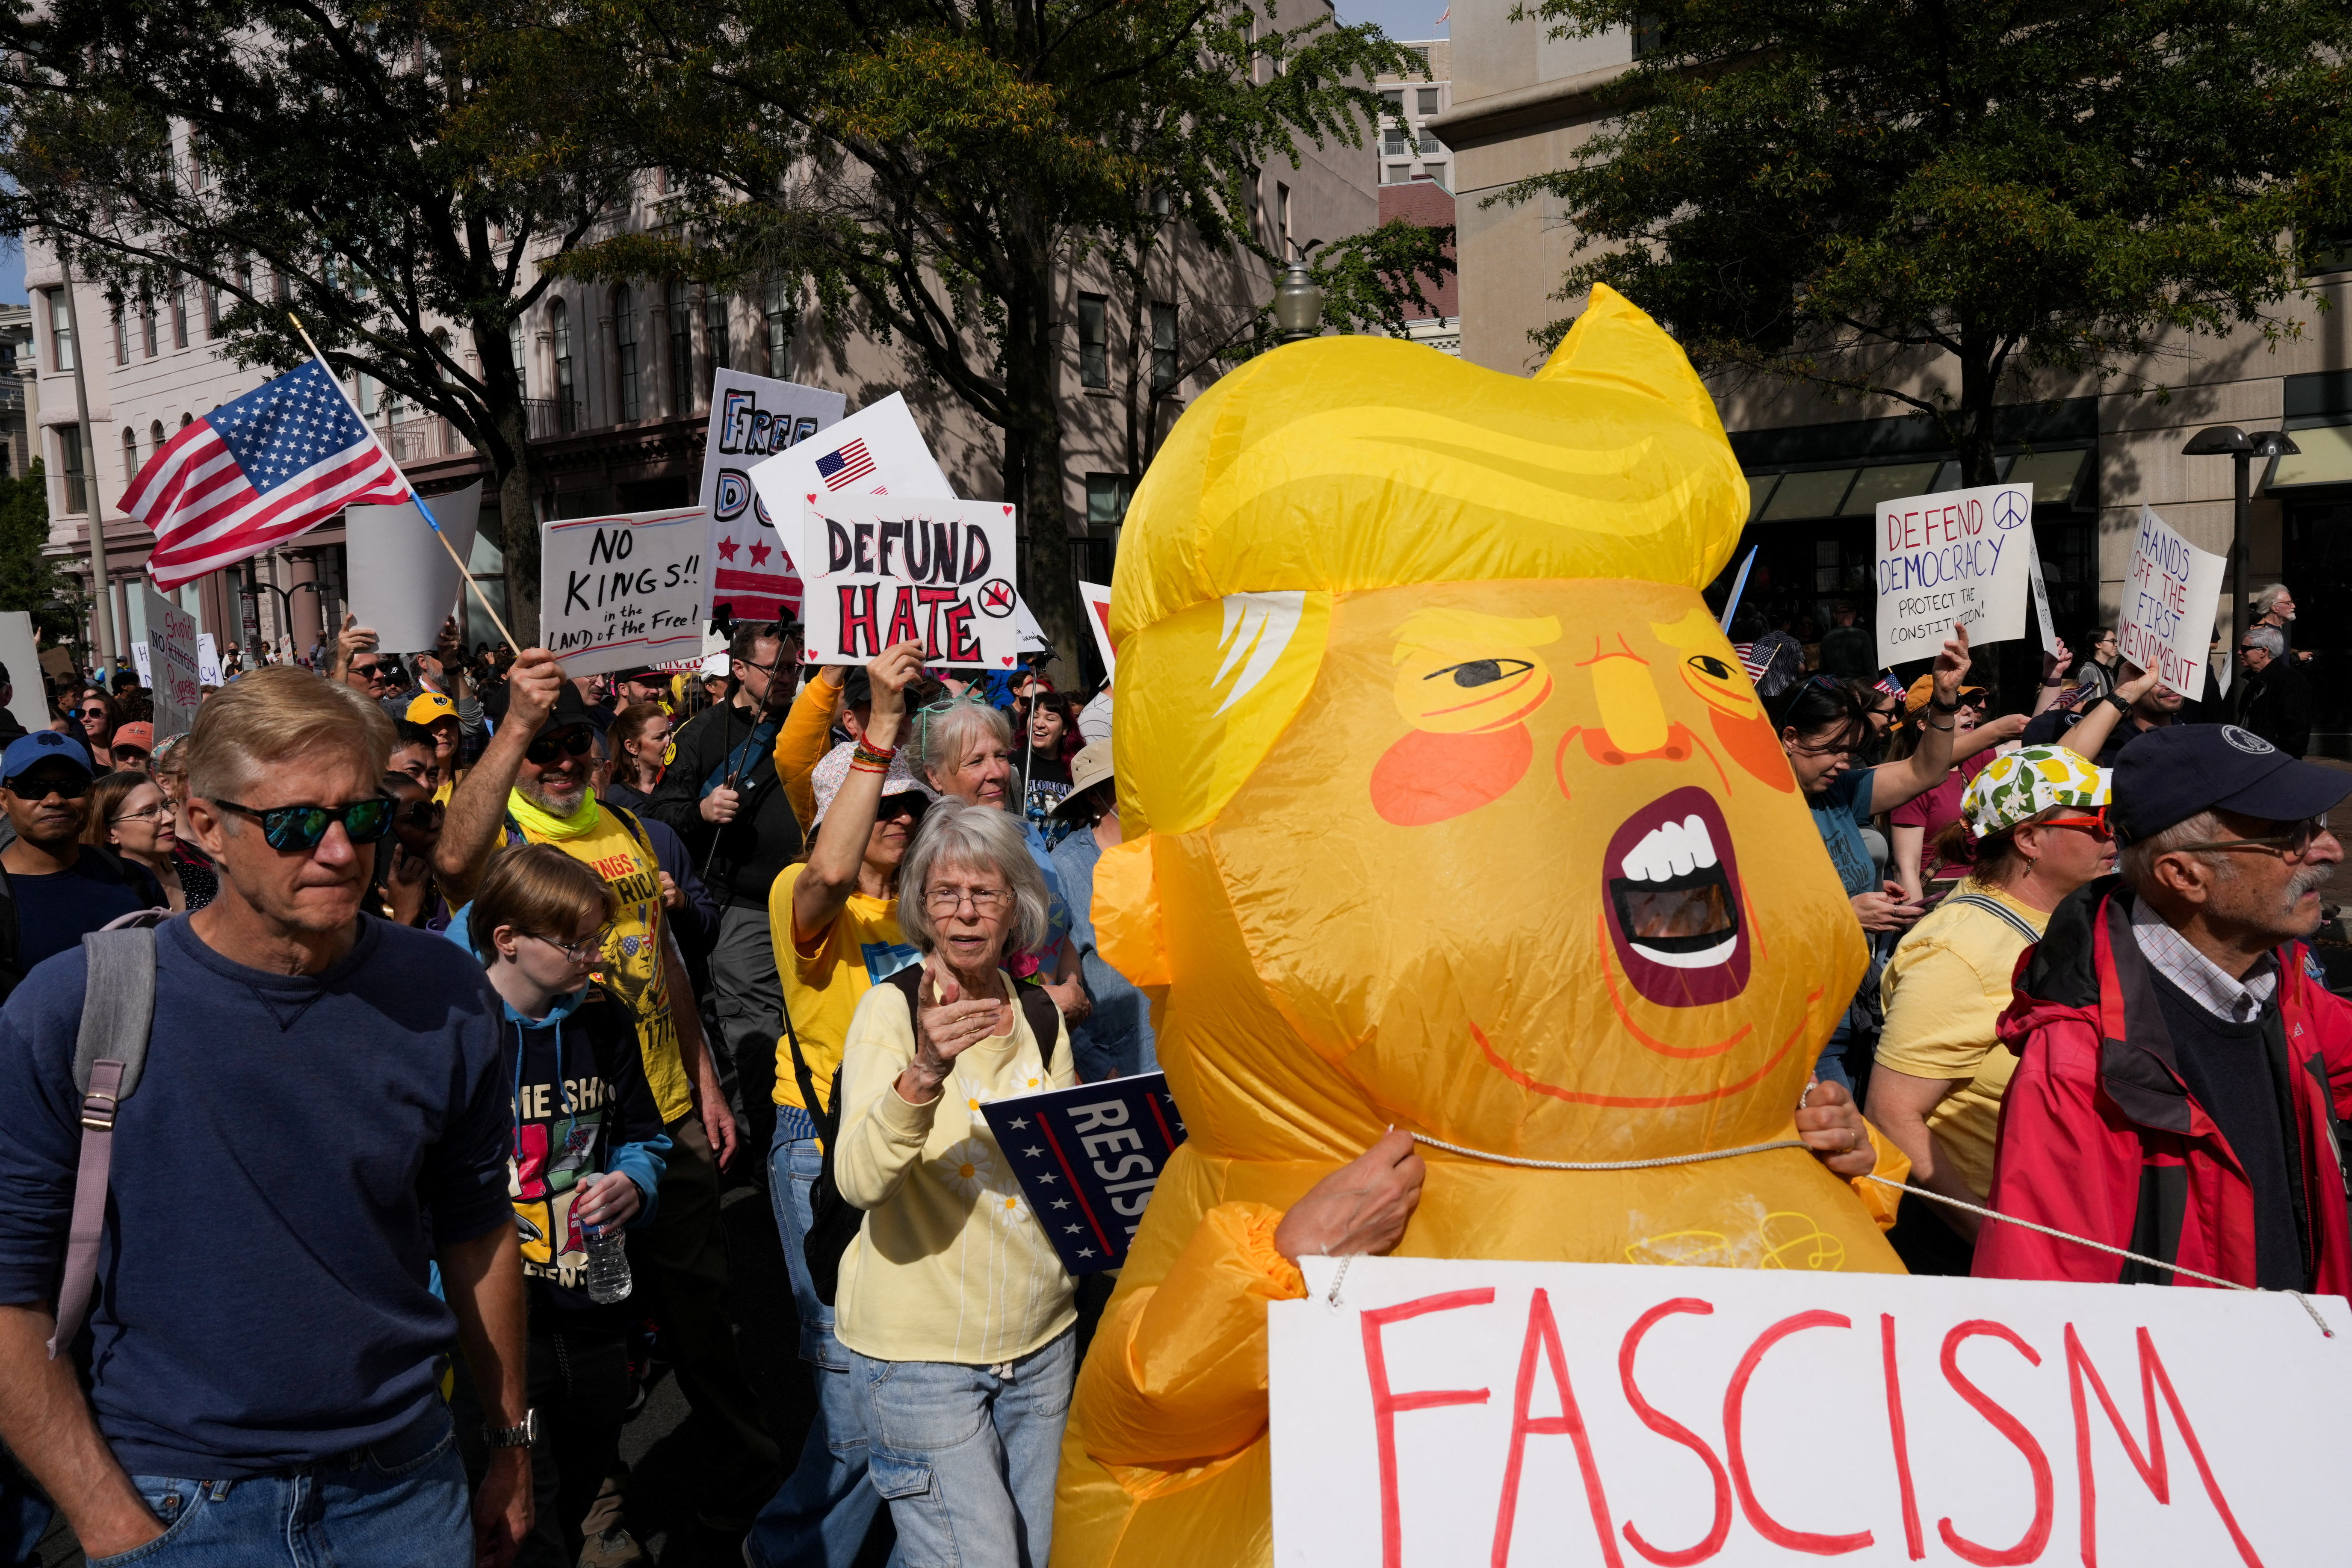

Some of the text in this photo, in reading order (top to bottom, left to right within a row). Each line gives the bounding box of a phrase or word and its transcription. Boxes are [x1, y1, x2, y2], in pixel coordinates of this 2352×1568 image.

[589, 528, 632, 565] NO
[1888, 499, 1983, 551] DEFEND
[2141, 514, 2189, 582] HANDS
[825, 518, 991, 585] DEFUND
[1880, 534, 2005, 595] DEMOCRACY
[564, 555, 699, 616] KINGS!!
[1899, 588, 1975, 618] PROTECT THE
[2133, 550, 2187, 614] OFF THE
[165, 611, 193, 647] Stupid
[548, 630, 593, 652] LAND
[598, 624, 617, 641] of
[621, 620, 645, 637] the
[604, 604, 643, 622] in the
[837, 582, 984, 662] HATE
[1891, 600, 1985, 644] CONSTITUTION!
[2137, 592, 2181, 642] FIRST
[151, 629, 165, 653] NO
[168, 641, 196, 674] KINGS
[2118, 612, 2198, 690] AMENDMENT
[587, 853, 635, 880] INGS
[606, 871, 657, 904] RICA
[511, 1077, 606, 1119] ME SHI
[1067, 1098, 1158, 1234] RESIS
[1360, 1285, 2266, 1568] FASCISM
